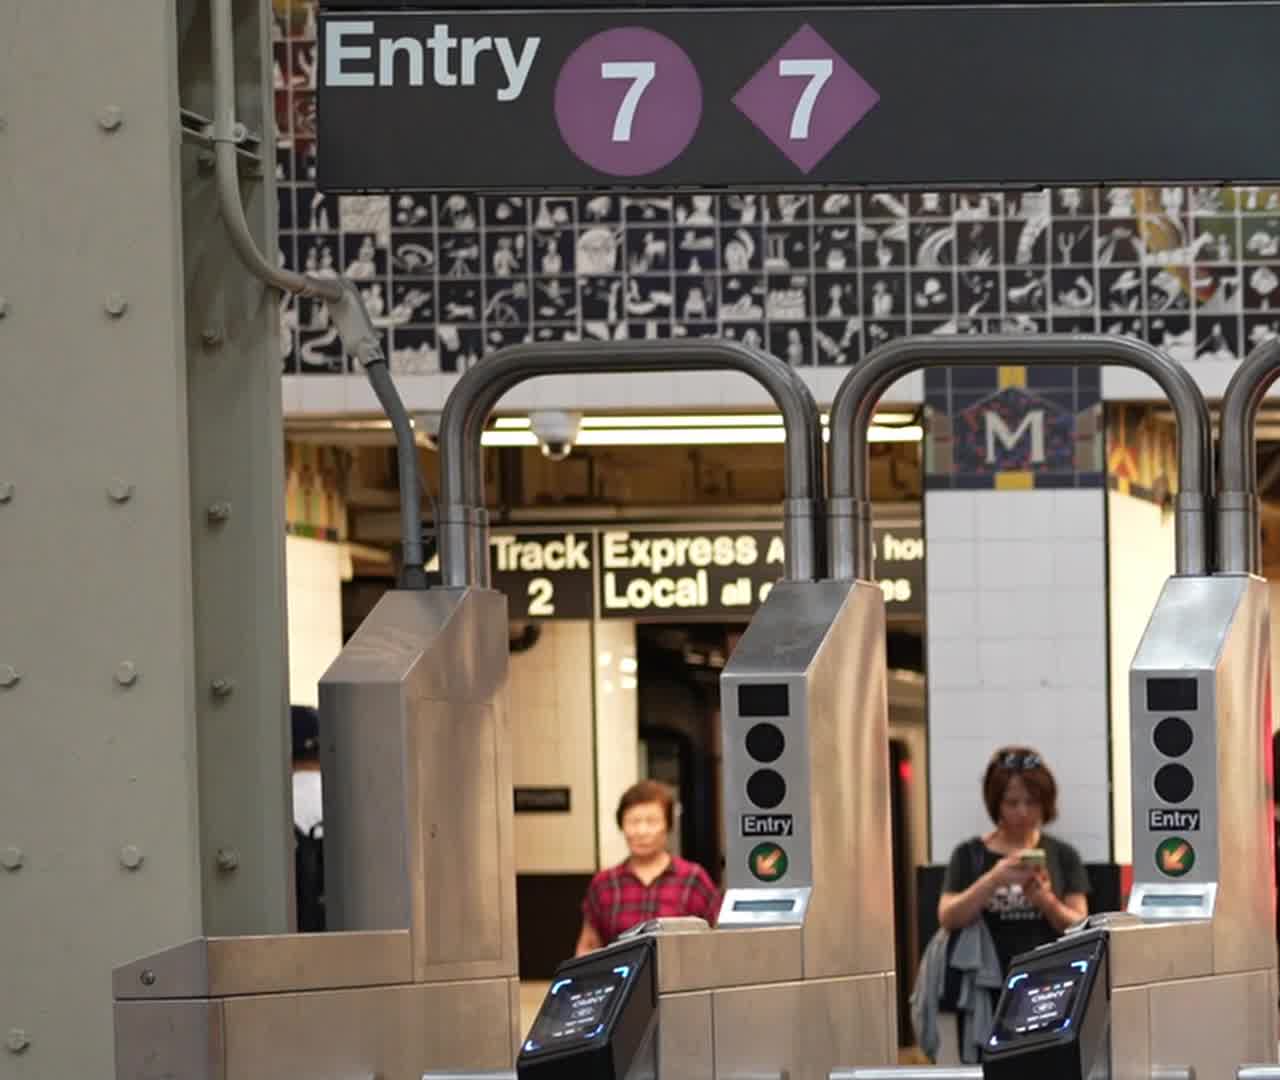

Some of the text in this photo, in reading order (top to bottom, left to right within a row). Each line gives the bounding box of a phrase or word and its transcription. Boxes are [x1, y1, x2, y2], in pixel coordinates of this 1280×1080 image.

[325, 20, 833, 142] Entry 7 7
[985, 411, 1044, 463] M
[490, 533, 590, 571] Track
[604, 531, 757, 574] Express
[528, 577, 554, 615] 2
[604, 568, 708, 608] Local
[745, 816, 791, 835] Entry
[1151, 811, 1198, 830] Entry
